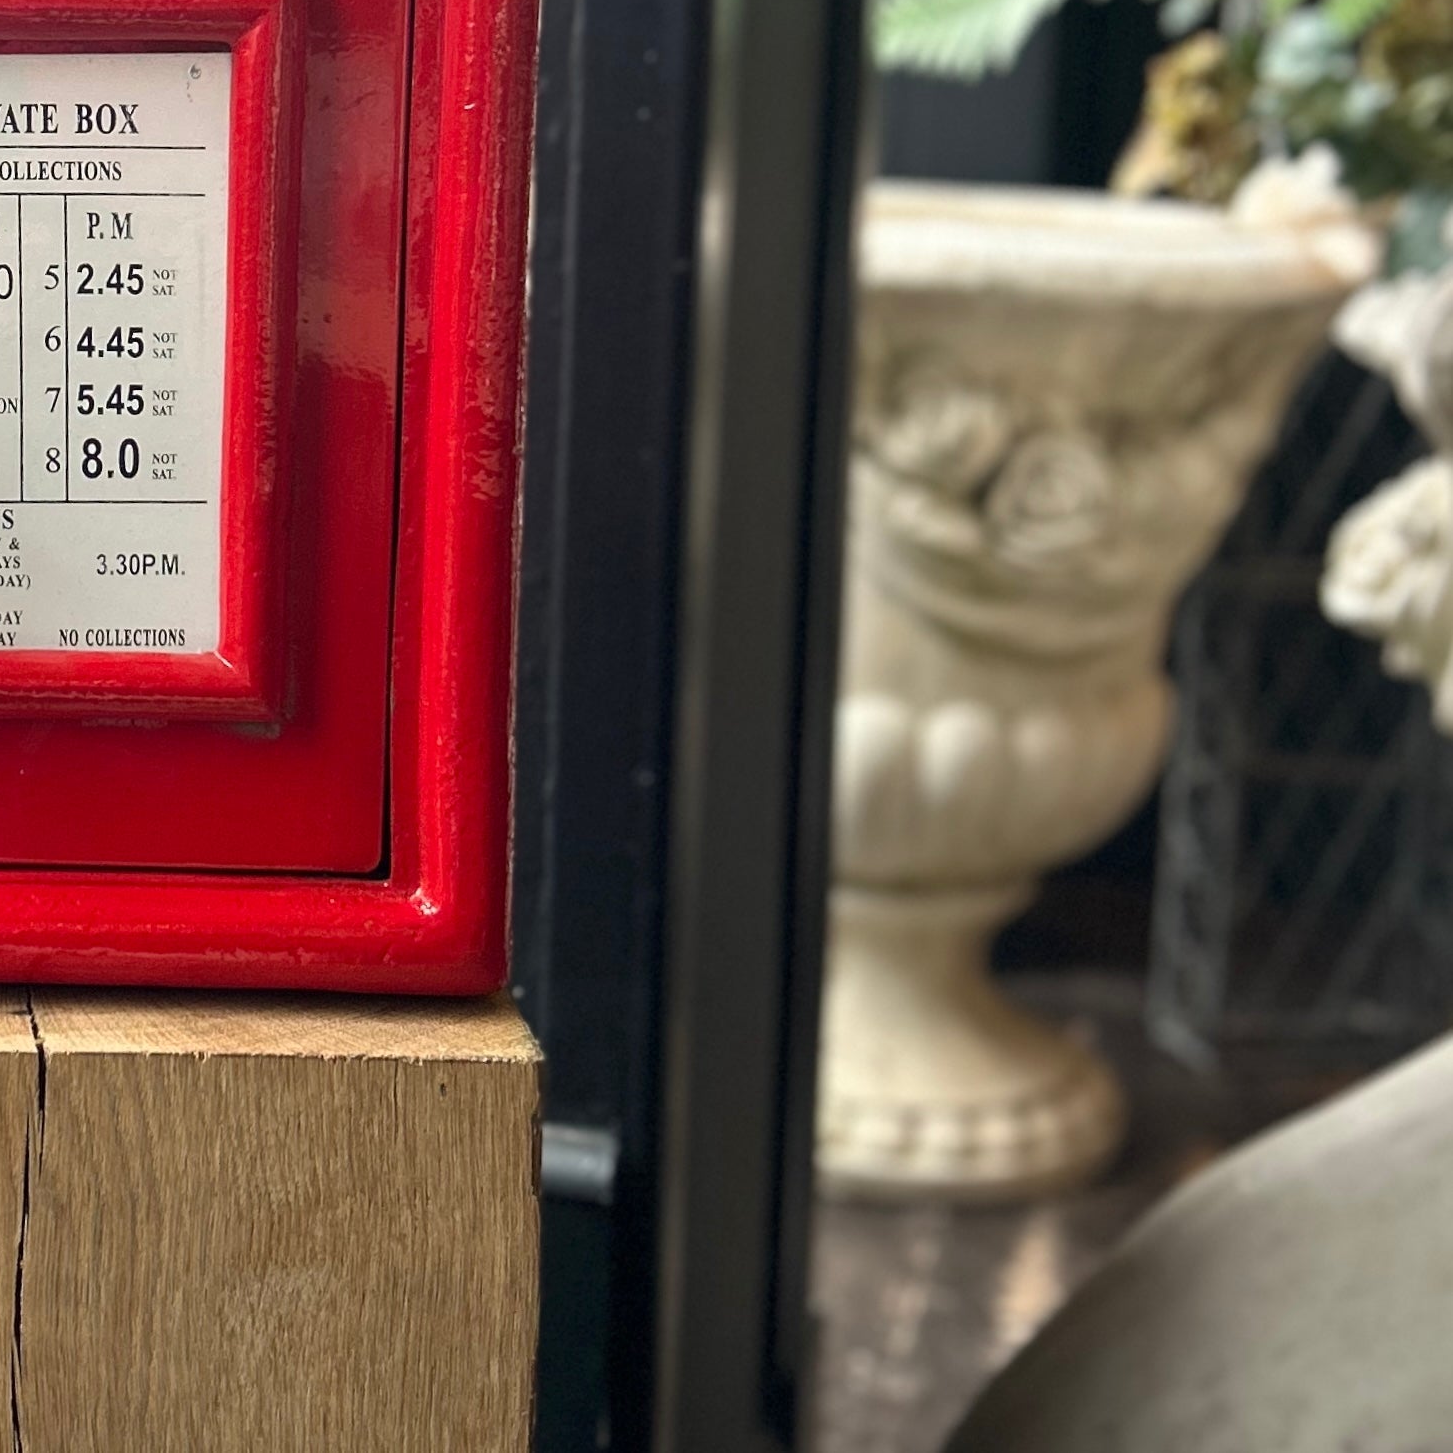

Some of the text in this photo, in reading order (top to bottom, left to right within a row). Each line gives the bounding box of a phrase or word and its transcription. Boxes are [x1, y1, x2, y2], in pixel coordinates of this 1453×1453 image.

[74, 103, 139, 135] BOX
[44, 263, 144, 296] 5 2.45
[152, 269, 176, 280] NOT
[44, 325, 145, 359] 6 4.45
[152, 332, 176, 343] NOT
[44, 384, 145, 416] 7 5.45
[152, 390, 176, 401] NOT
[45, 437, 140, 480] 8 8.0
[152, 453, 176, 465] NOT
[8, 537, 20, 551] &
[59, 628, 186, 647] NO COLLECTIONS
